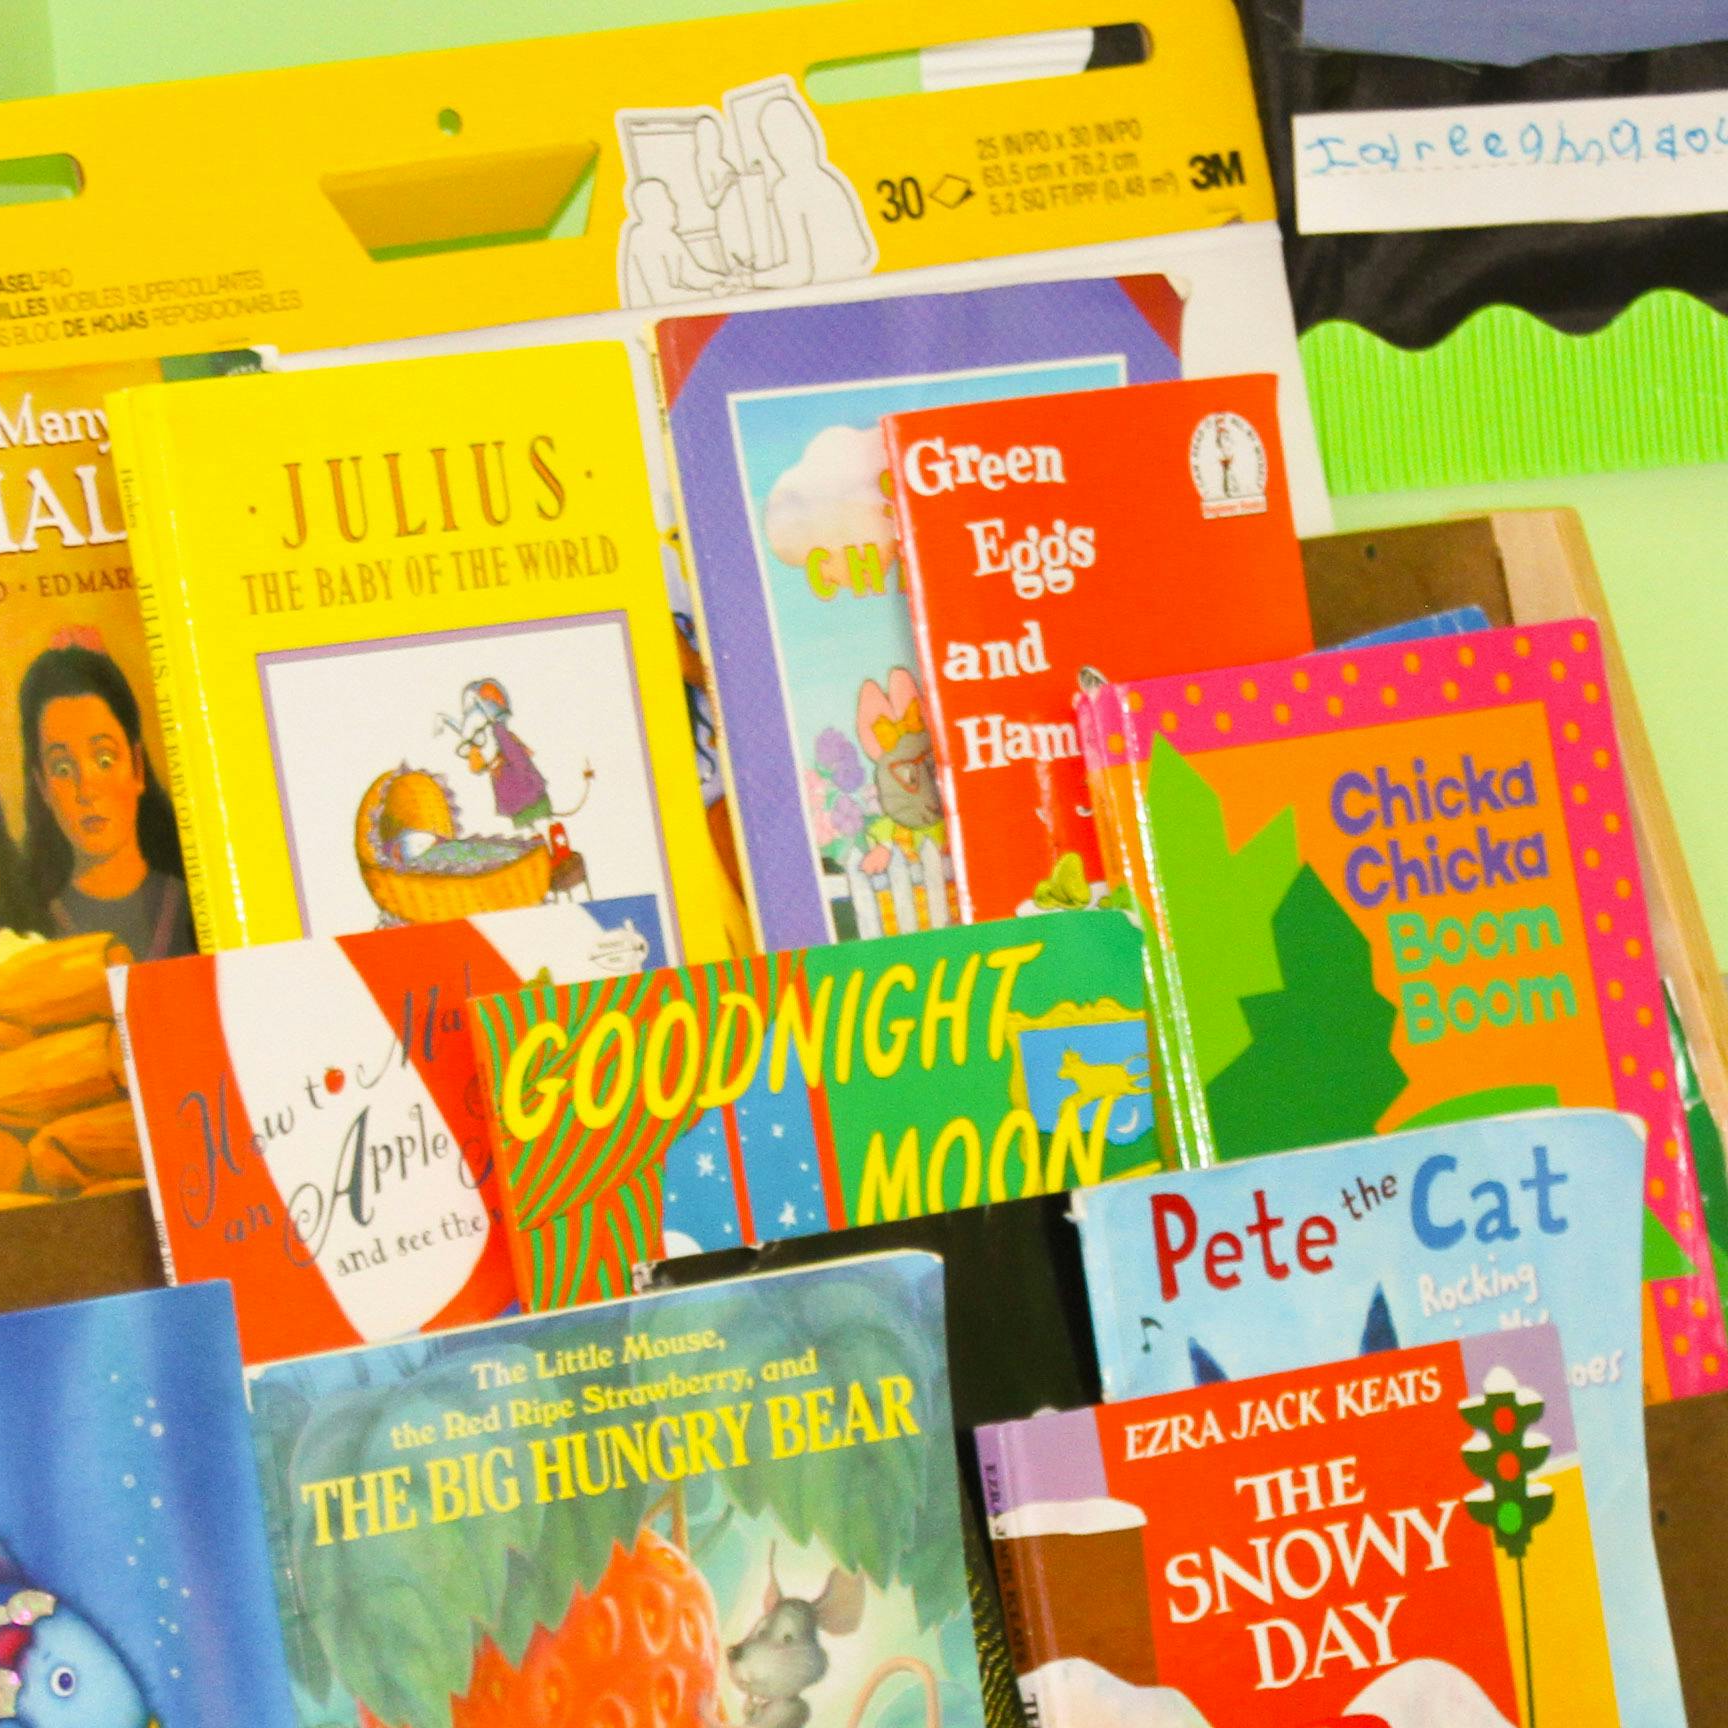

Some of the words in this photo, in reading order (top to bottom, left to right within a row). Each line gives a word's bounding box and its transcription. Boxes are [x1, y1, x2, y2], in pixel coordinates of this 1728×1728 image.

[876, 177, 924, 223] 30
[1188, 150, 1246, 190] 3M
[62, 316, 86, 339] DE
[92, 309, 149, 334] HOJAS
[281, 434, 568, 550] JULIUS
[902, 436, 1066, 497] Green
[38, 574, 71, 598] ED
[241, 569, 305, 617] THE
[314, 560, 395, 609] BABY
[405, 552, 445, 597] OF
[451, 543, 512, 592] THE
[517, 532, 621, 583] WORLD
[965, 518, 1097, 600] Eggs
[942, 621, 1050, 683] and
[956, 713, 1083, 772] Ham
[1329, 753, 1538, 838] Chicka
[1344, 826, 1550, 909] Chicka
[1385, 902, 1566, 975] Boom
[501, 942, 1044, 1143] GOODNIGHT
[1398, 971, 1577, 1046] Boom
[177, 1072, 296, 1229] How
[223, 1203, 273, 1243] an
[284, 1103, 452, 1267] Apple
[858, 1092, 1117, 1227] MOON
[336, 1238, 388, 1277] and
[395, 1229, 434, 1256] see
[440, 1212, 486, 1243] the
[1149, 1188, 1340, 1302] Pete
[1340, 1172, 1400, 1222] the
[1409, 1144, 1570, 1250] Cat
[1418, 1252, 1539, 1318] Rocking
[471, 1357, 527, 1393] The
[533, 1342, 613, 1382] Little
[621, 1322, 728, 1366] Mouse,
[391, 1417, 436, 1452] the
[443, 1405, 504, 1443] Red
[509, 1390, 576, 1434] Ripe
[582, 1361, 754, 1417] Strawberry,
[760, 1346, 819, 1385] and
[1123, 1411, 1225, 1462] EZRA
[1230, 1388, 1325, 1442] JACK
[1334, 1364, 1443, 1419] KEATS
[301, 1463, 417, 1549] THE
[427, 1446, 522, 1517] BIG
[529, 1403, 754, 1507] HUNGRY
[768, 1374, 921, 1462] BEAR
[1235, 1456, 1368, 1524] THE
[1164, 1498, 1459, 1627] SNOWY
[1247, 1594, 1406, 1694] DAY
